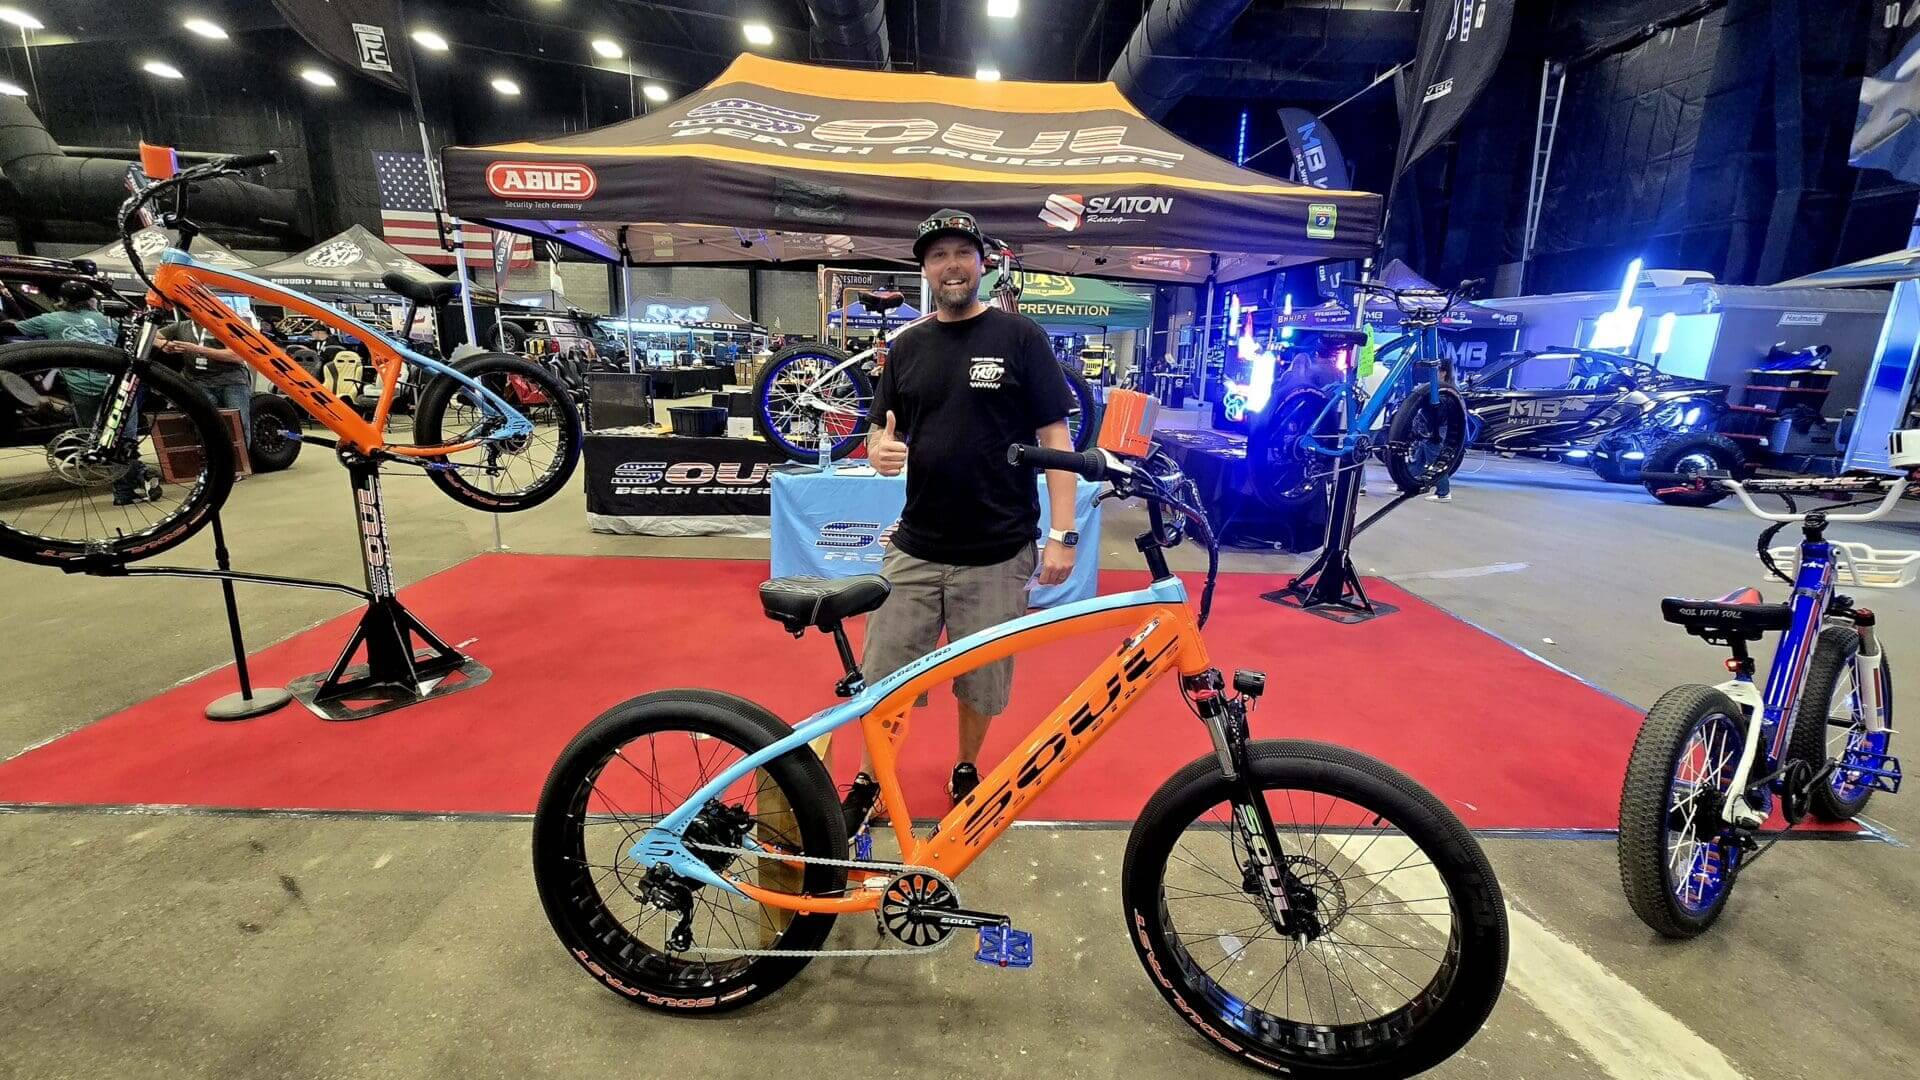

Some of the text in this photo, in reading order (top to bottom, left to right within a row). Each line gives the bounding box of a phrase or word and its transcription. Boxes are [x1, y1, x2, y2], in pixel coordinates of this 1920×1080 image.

[668, 98, 1184, 160] SOUL
[671, 127, 1176, 168] BEACH CRUISERS
[1297, 121, 1327, 173] MB
[503, 170, 581, 191] ABUS
[505, 201, 582, 210] Security Tech Germany
[1086, 196, 1173, 214] SLATON
[1086, 215, 1124, 224] Racing
[1318, 216, 1326, 226] 2
[314, 279, 338, 287] MADE
[1018, 303, 1110, 317] PREVENTION
[179, 276, 346, 424] SOUL
[98, 371, 137, 449] SOUL
[1509, 399, 1561, 418] MB
[1507, 417, 1559, 425] WHIPS
[614, 487, 772, 495] BEACH CRUISE
[358, 476, 391, 597] SOUL
[824, 552, 884, 561] FAS
[925, 647, 952, 662] PRO
[964, 635, 1179, 846] SOUL
[1239, 803, 1289, 926] SOUL
[940, 917, 976, 926] SOUL
[573, 947, 717, 1008] SOUL FAST
[1133, 907, 1244, 1054] FAST SOUL
